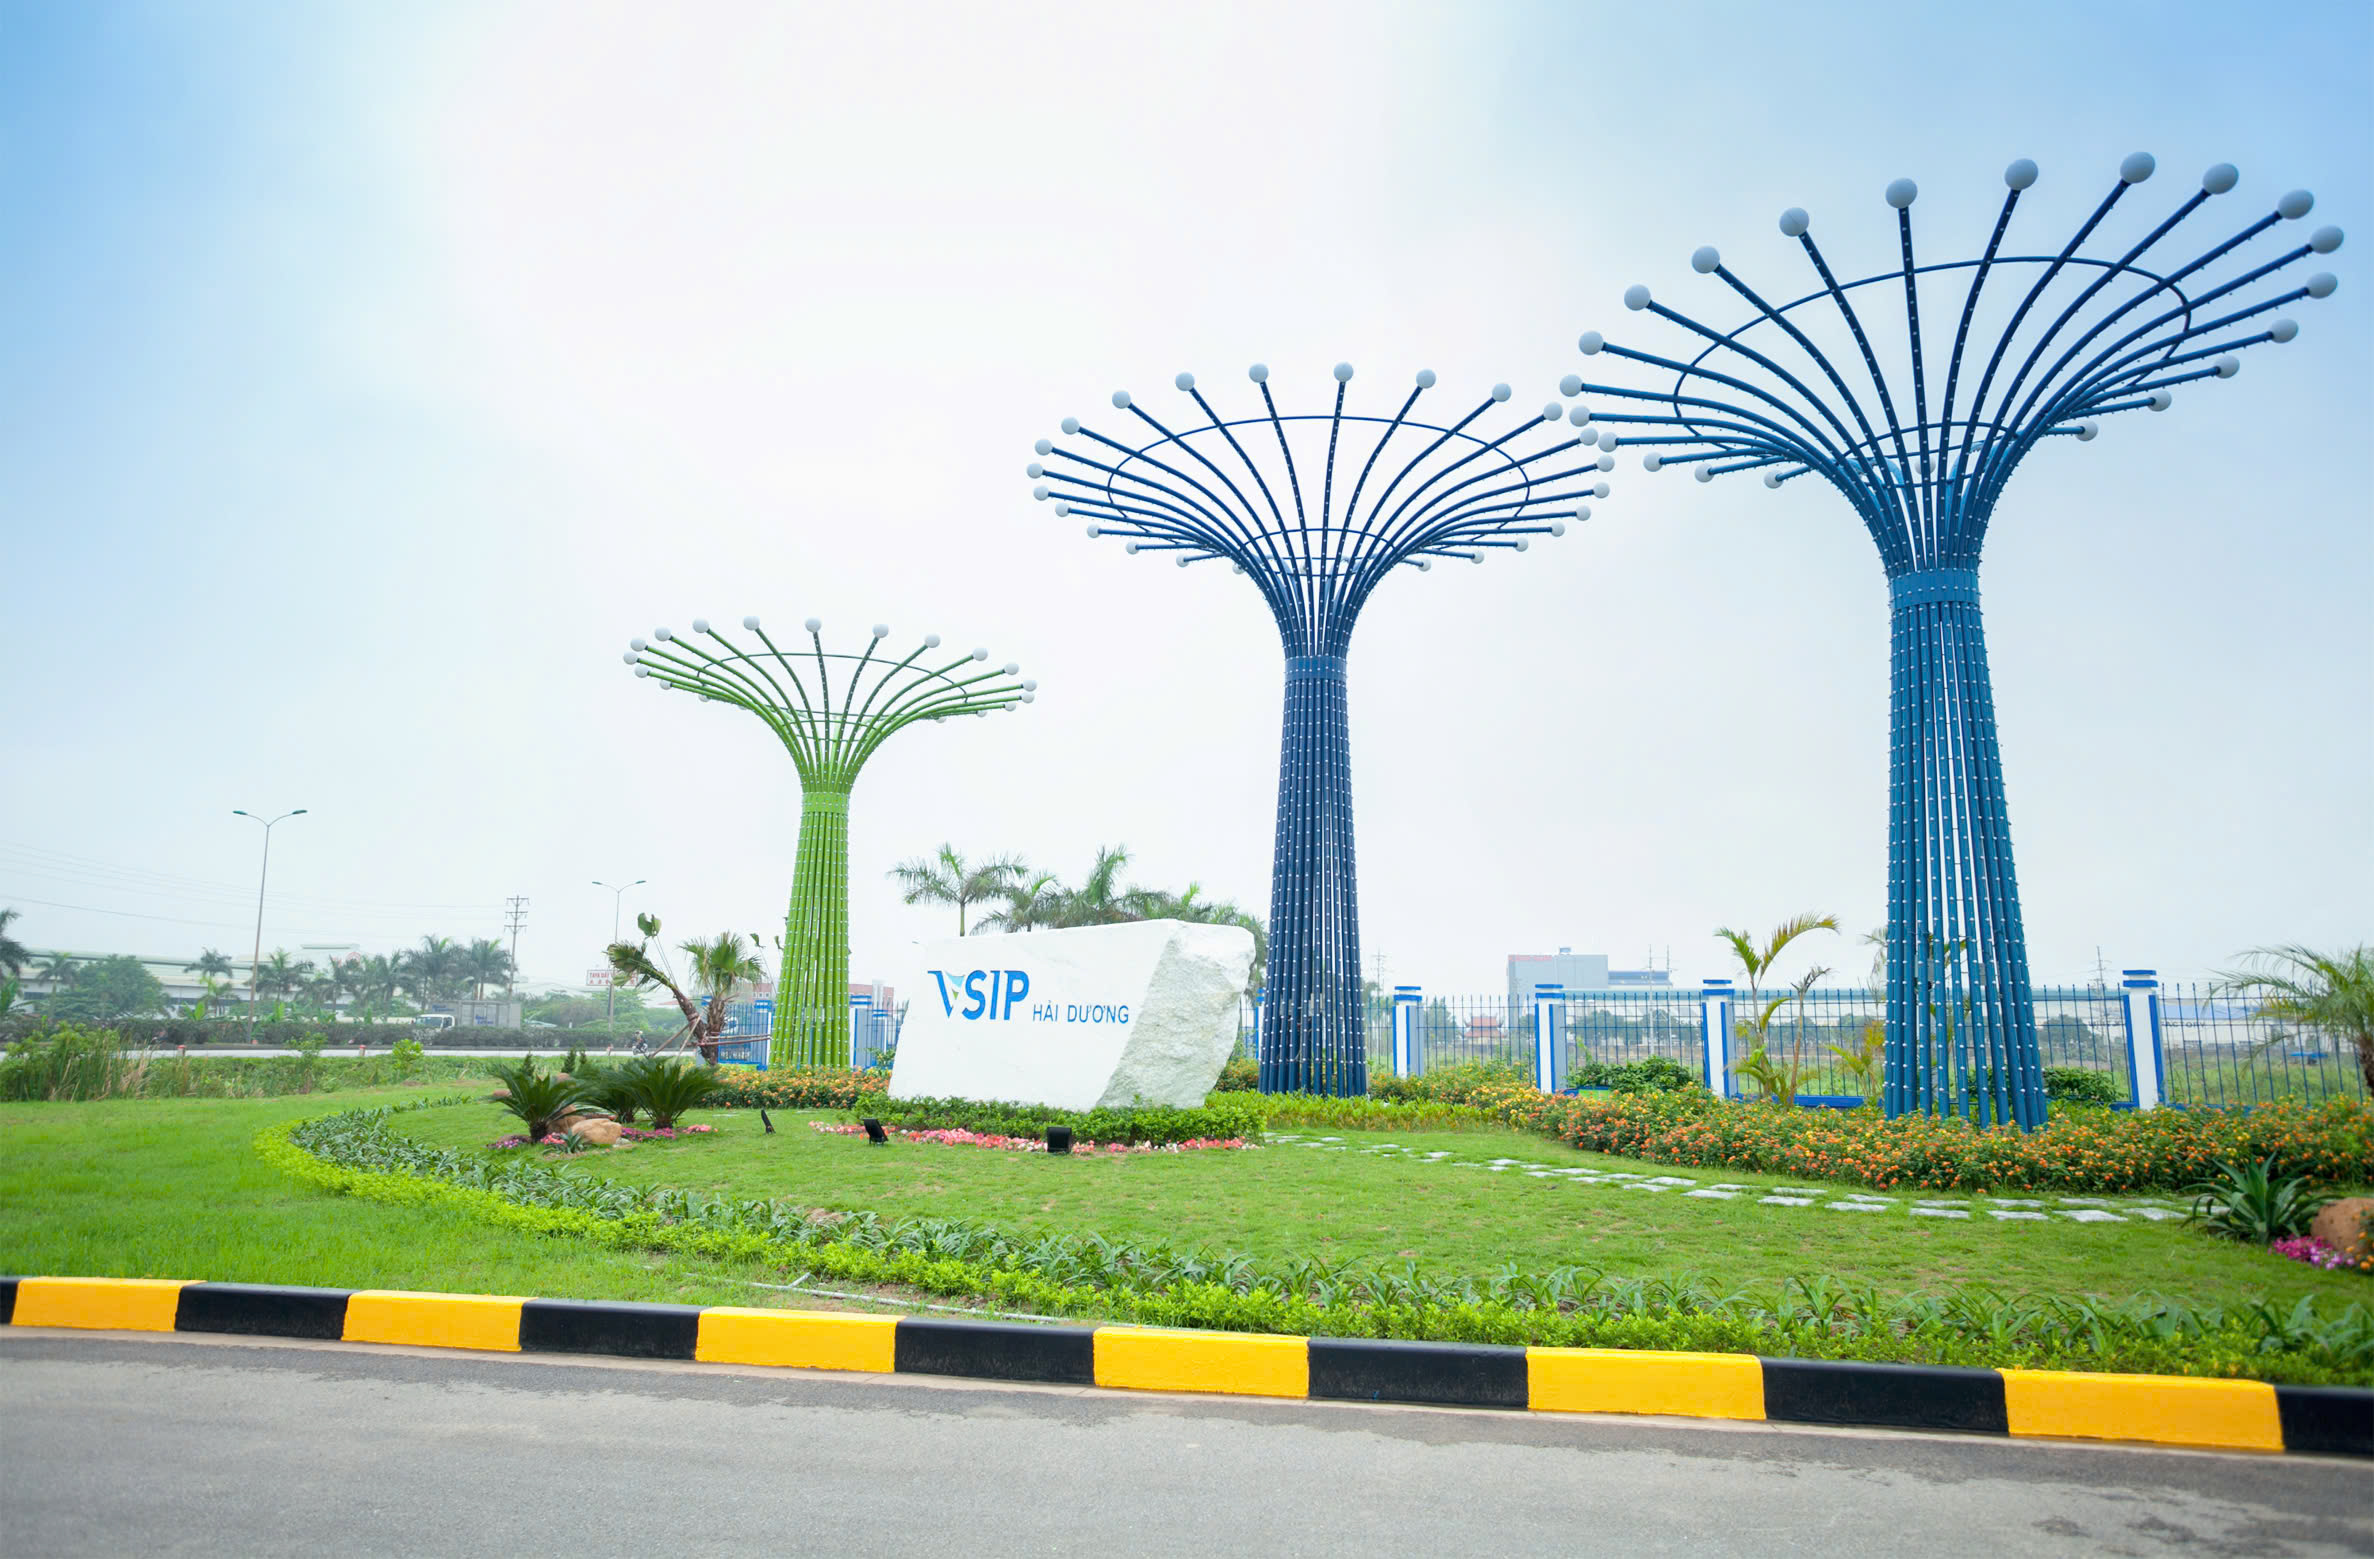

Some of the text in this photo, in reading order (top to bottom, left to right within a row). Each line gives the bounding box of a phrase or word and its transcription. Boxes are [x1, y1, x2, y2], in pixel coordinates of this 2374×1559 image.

[927, 970, 1129, 1025] VSIP HẢI DƯƠNG
